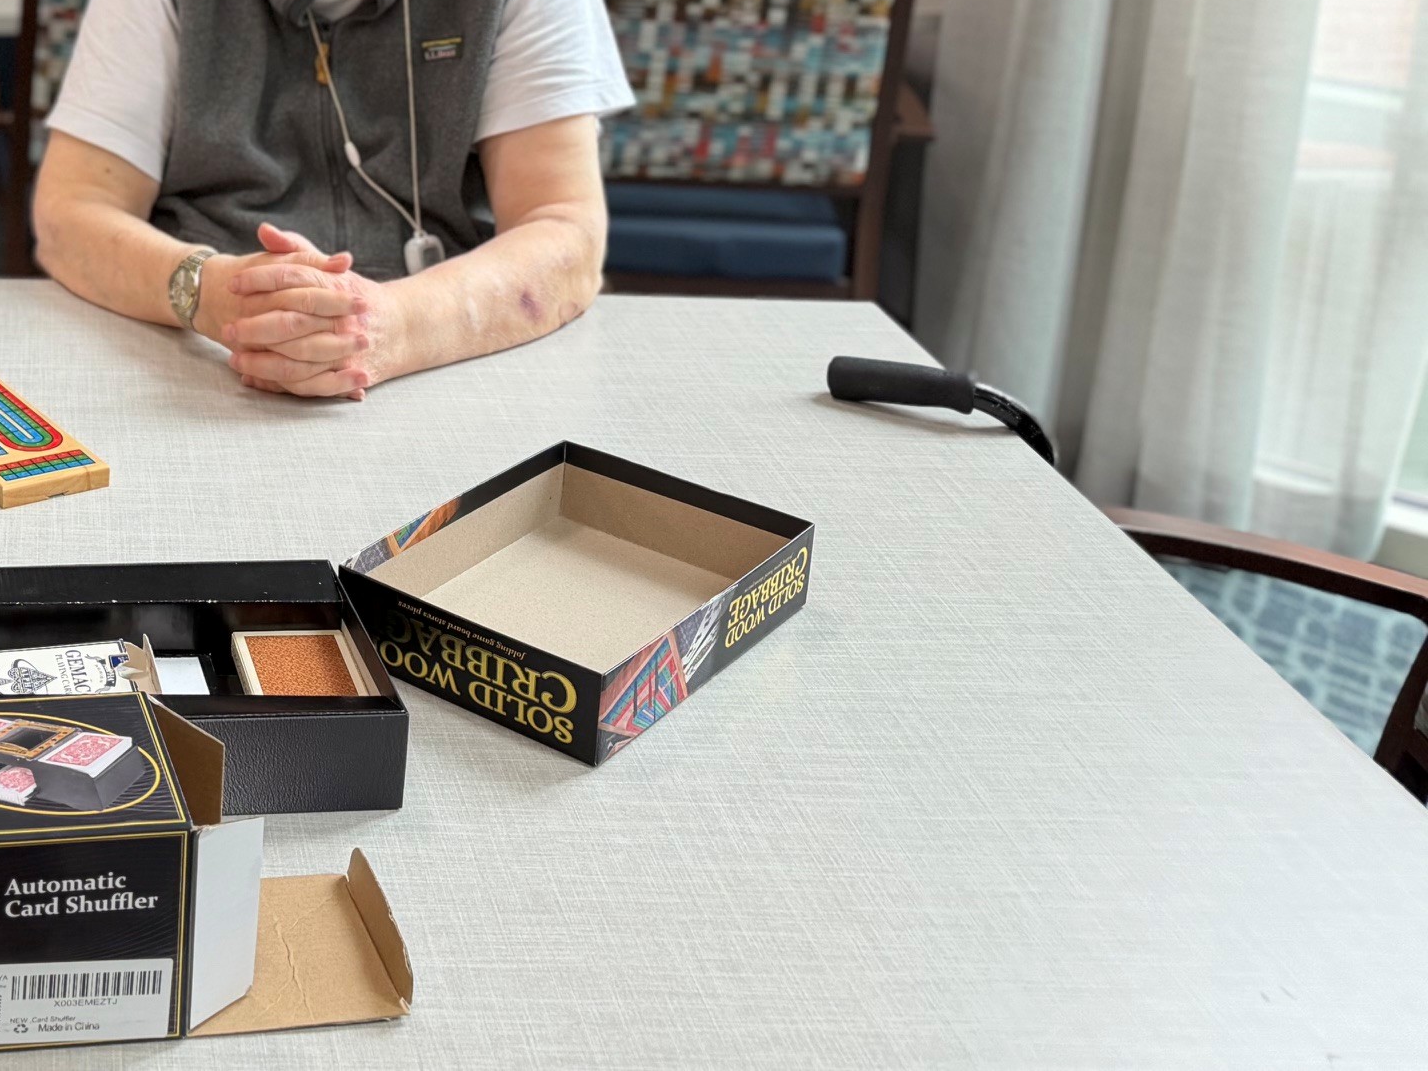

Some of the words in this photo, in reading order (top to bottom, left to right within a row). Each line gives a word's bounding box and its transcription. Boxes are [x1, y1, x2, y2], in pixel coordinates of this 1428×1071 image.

[727, 546, 808, 629] CRIBBAGE
[768, 573, 805, 615] SOLID
[397, 601, 422, 616] pieces
[422, 613, 447, 628] stores
[448, 623, 471, 638] board
[724, 604, 766, 648] WOOD
[472, 633, 496, 647] game
[496, 642, 527, 660] folding
[65, 649, 92, 694] GEMAC
[375, 637, 461, 696] WOO
[387, 611, 578, 714] CRIBBAG
[468, 681, 574, 744] SOLID
[4, 871, 127, 896] Automatic
[5, 897, 59, 918] Card
[65, 892, 159, 915] Shuffler
[53, 998, 118, 1008] X003EMEZTJ
[38, 1023, 63, 1032] Made
[65, 1023, 73, 1031] in
[74, 1022, 100, 1031] China
[50, 1015, 76, 1023] Shuffler
